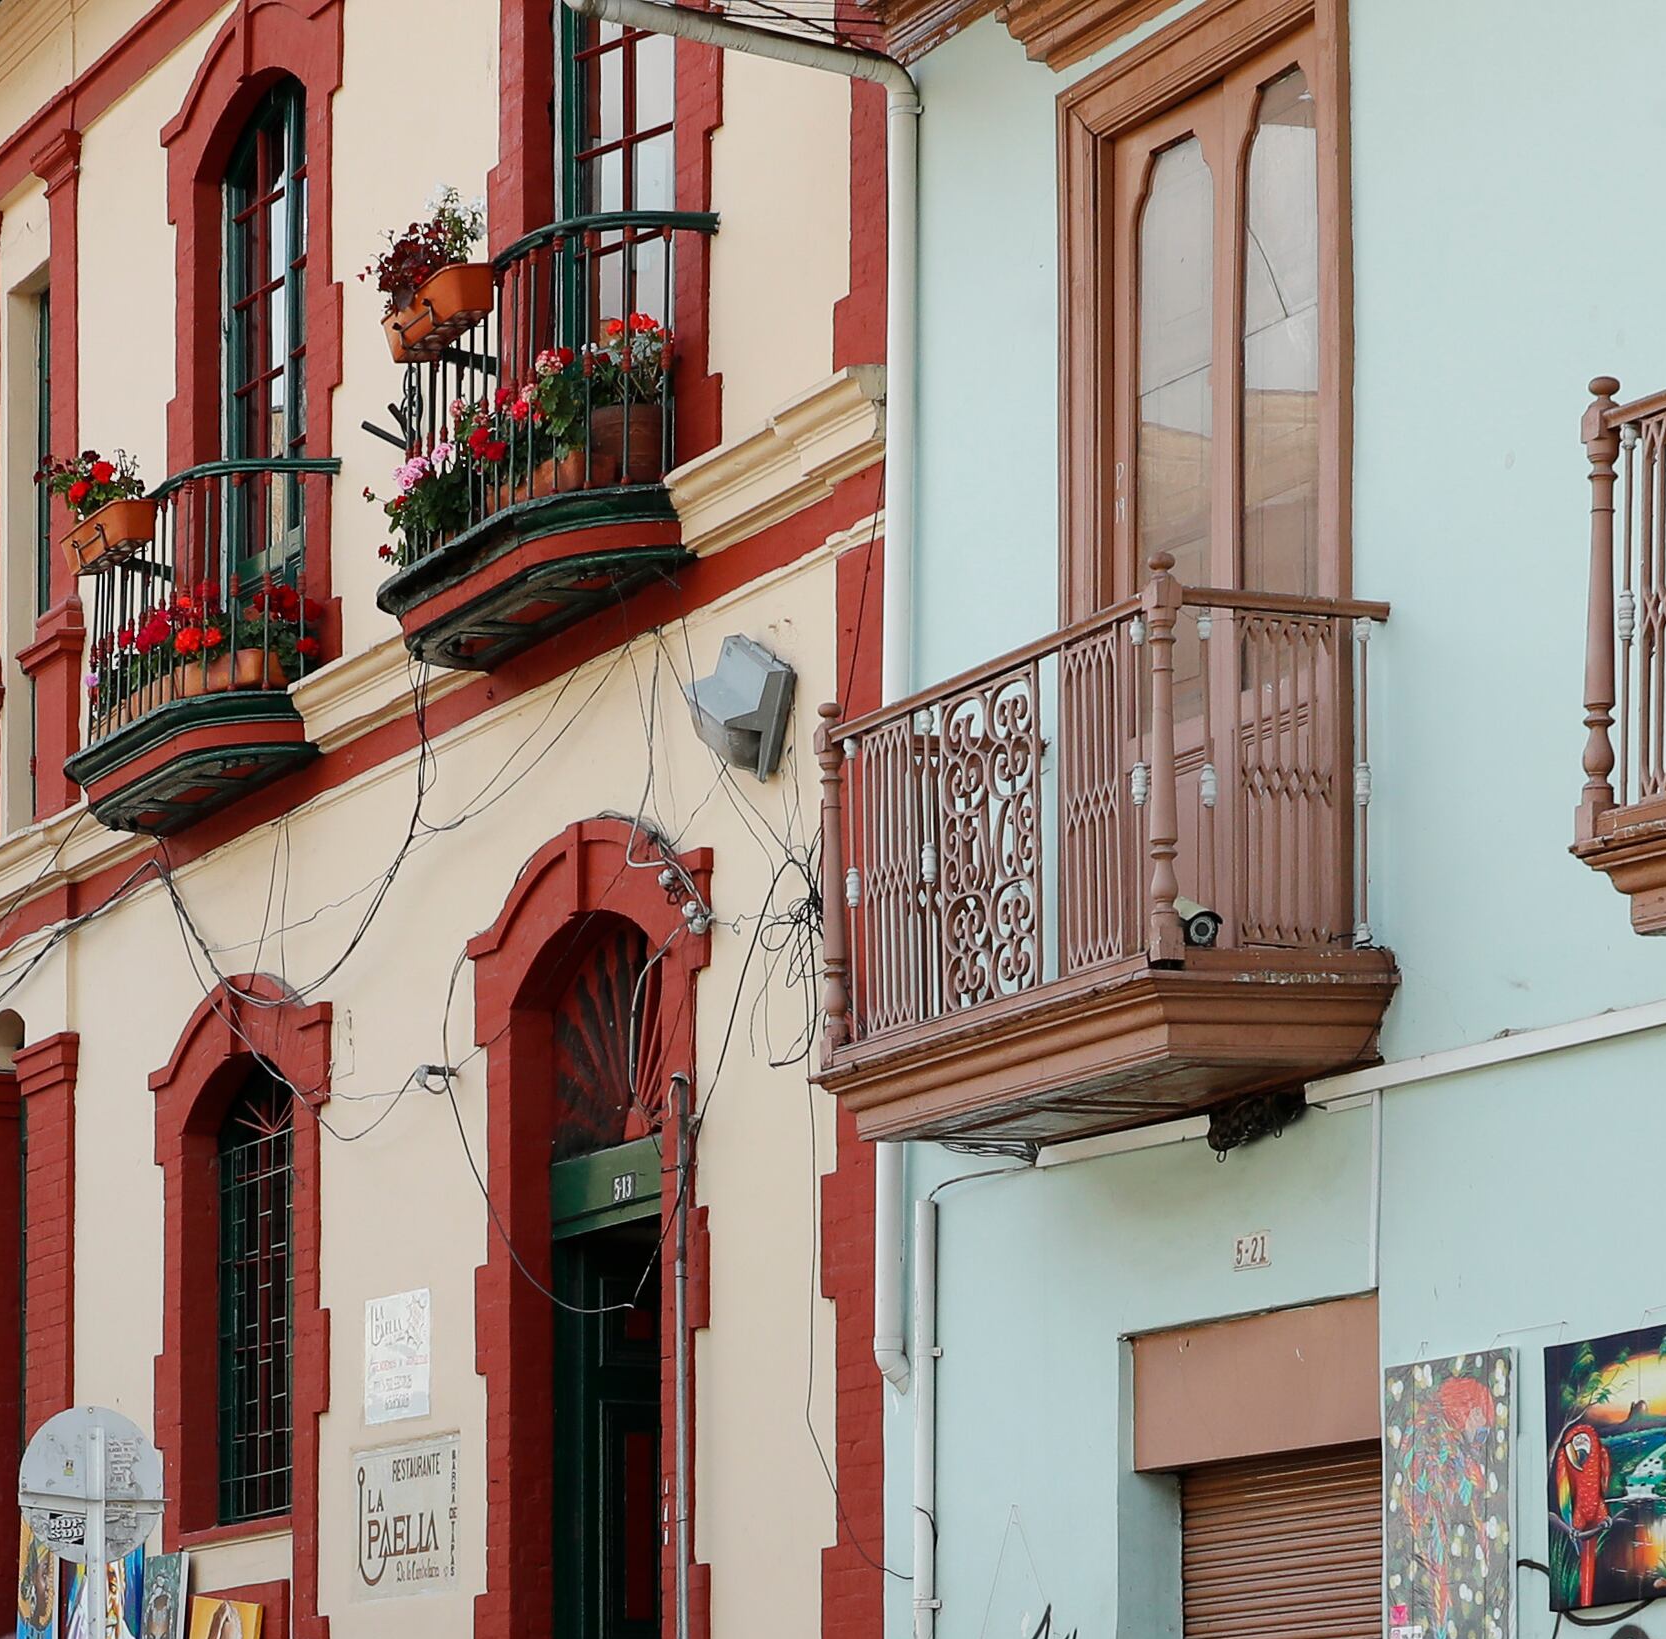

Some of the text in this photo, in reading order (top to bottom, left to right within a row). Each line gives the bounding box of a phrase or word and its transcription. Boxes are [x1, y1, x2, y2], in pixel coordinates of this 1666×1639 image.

[1235, 1235, 1267, 1265] 5-21
[392, 1452, 441, 1483] RESTAURANTE
[367, 1488, 385, 1514] LA
[366, 1509, 440, 1560] PAELLA
